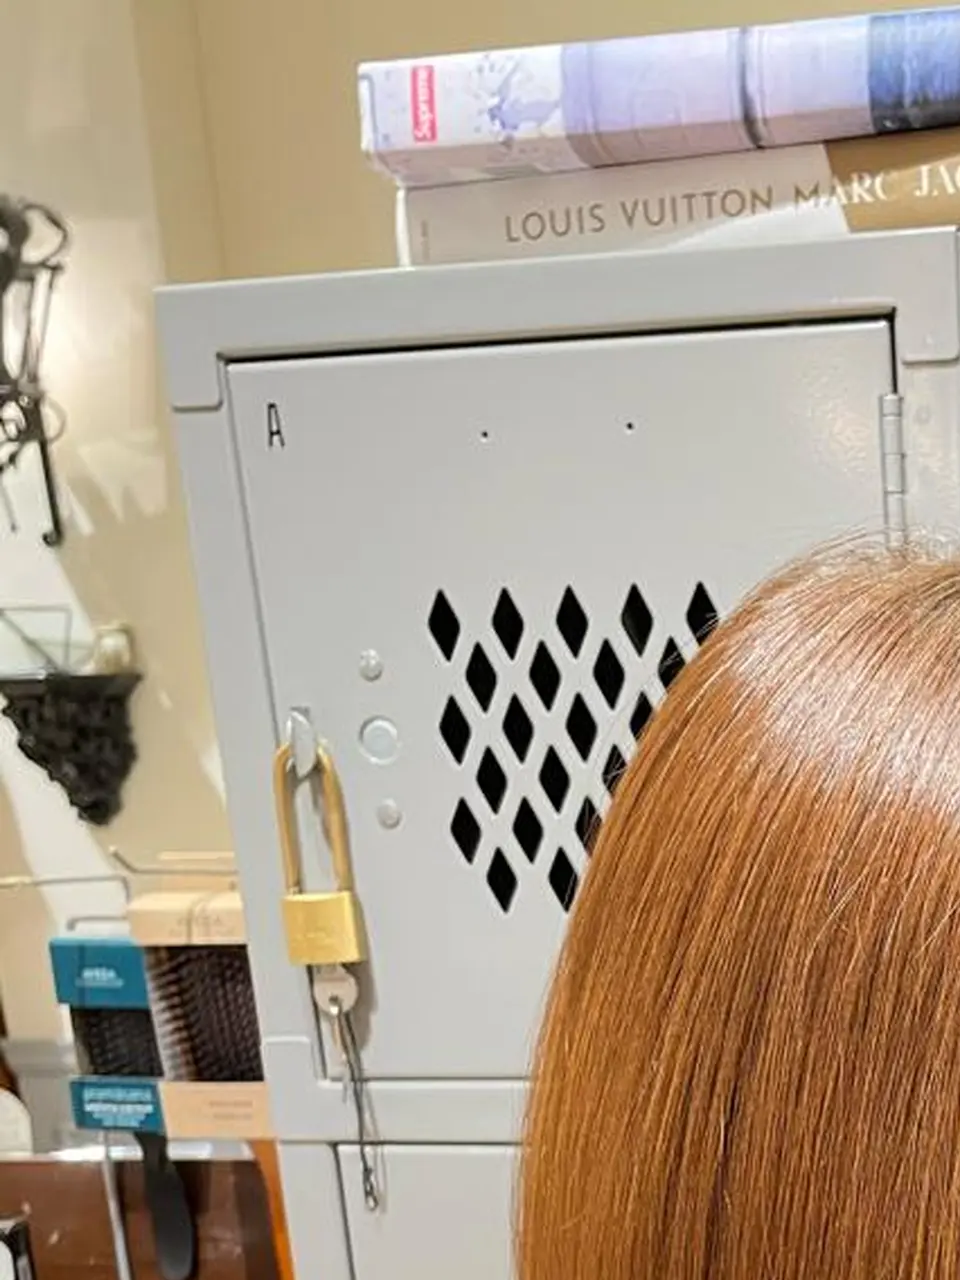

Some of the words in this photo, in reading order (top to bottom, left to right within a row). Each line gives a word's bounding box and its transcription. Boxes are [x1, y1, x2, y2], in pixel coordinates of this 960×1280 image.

[505, 203, 606, 243] LOUIS
[620, 185, 773, 230] VUITTON
[794, 169, 897, 208] MARC
[267, 402, 285, 447] A
